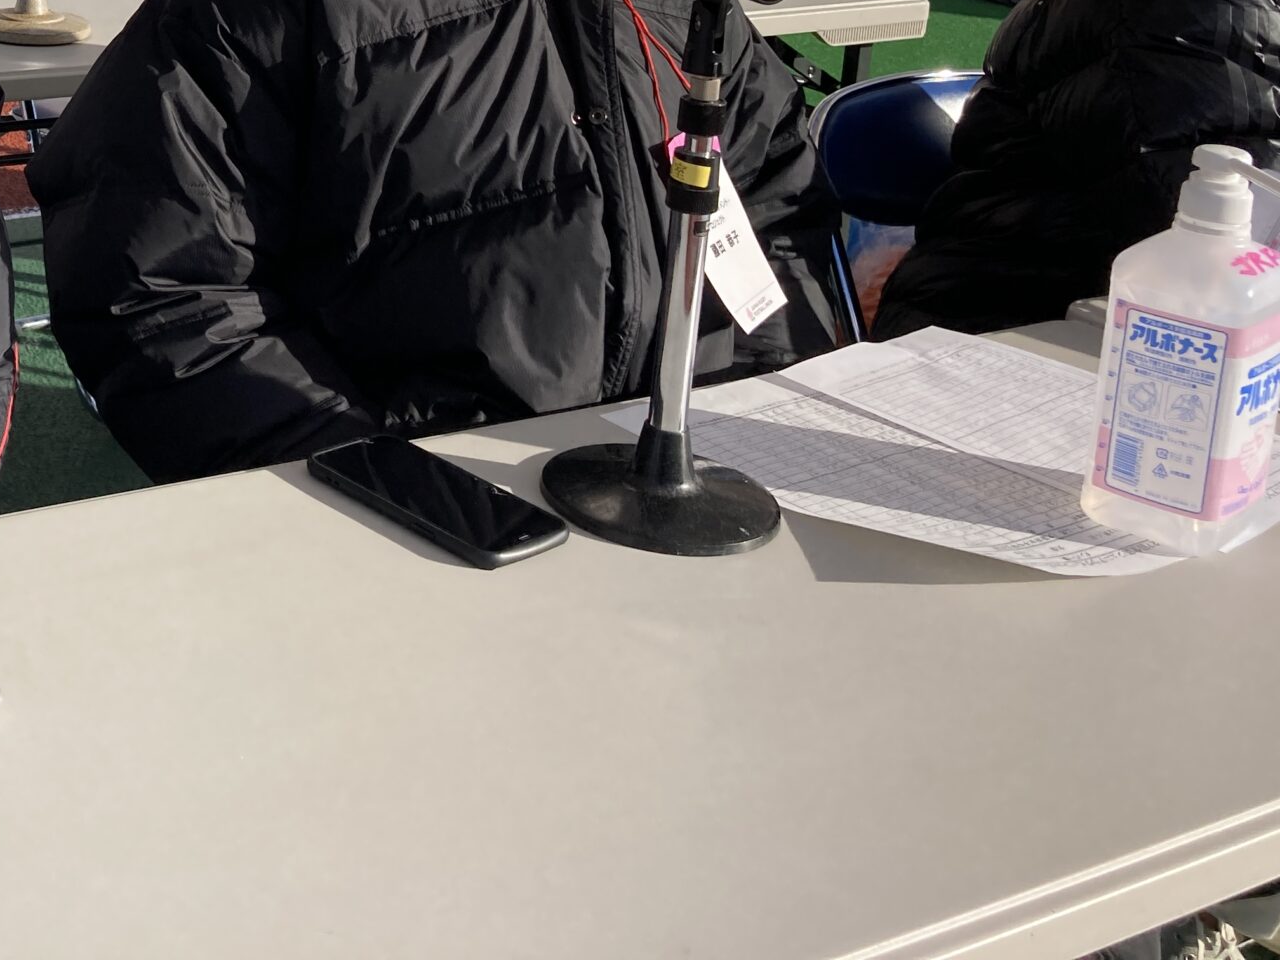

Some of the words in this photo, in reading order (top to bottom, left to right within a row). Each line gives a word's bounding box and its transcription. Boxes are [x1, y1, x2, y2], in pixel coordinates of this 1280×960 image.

[1129, 323, 1218, 363] アルボナース
